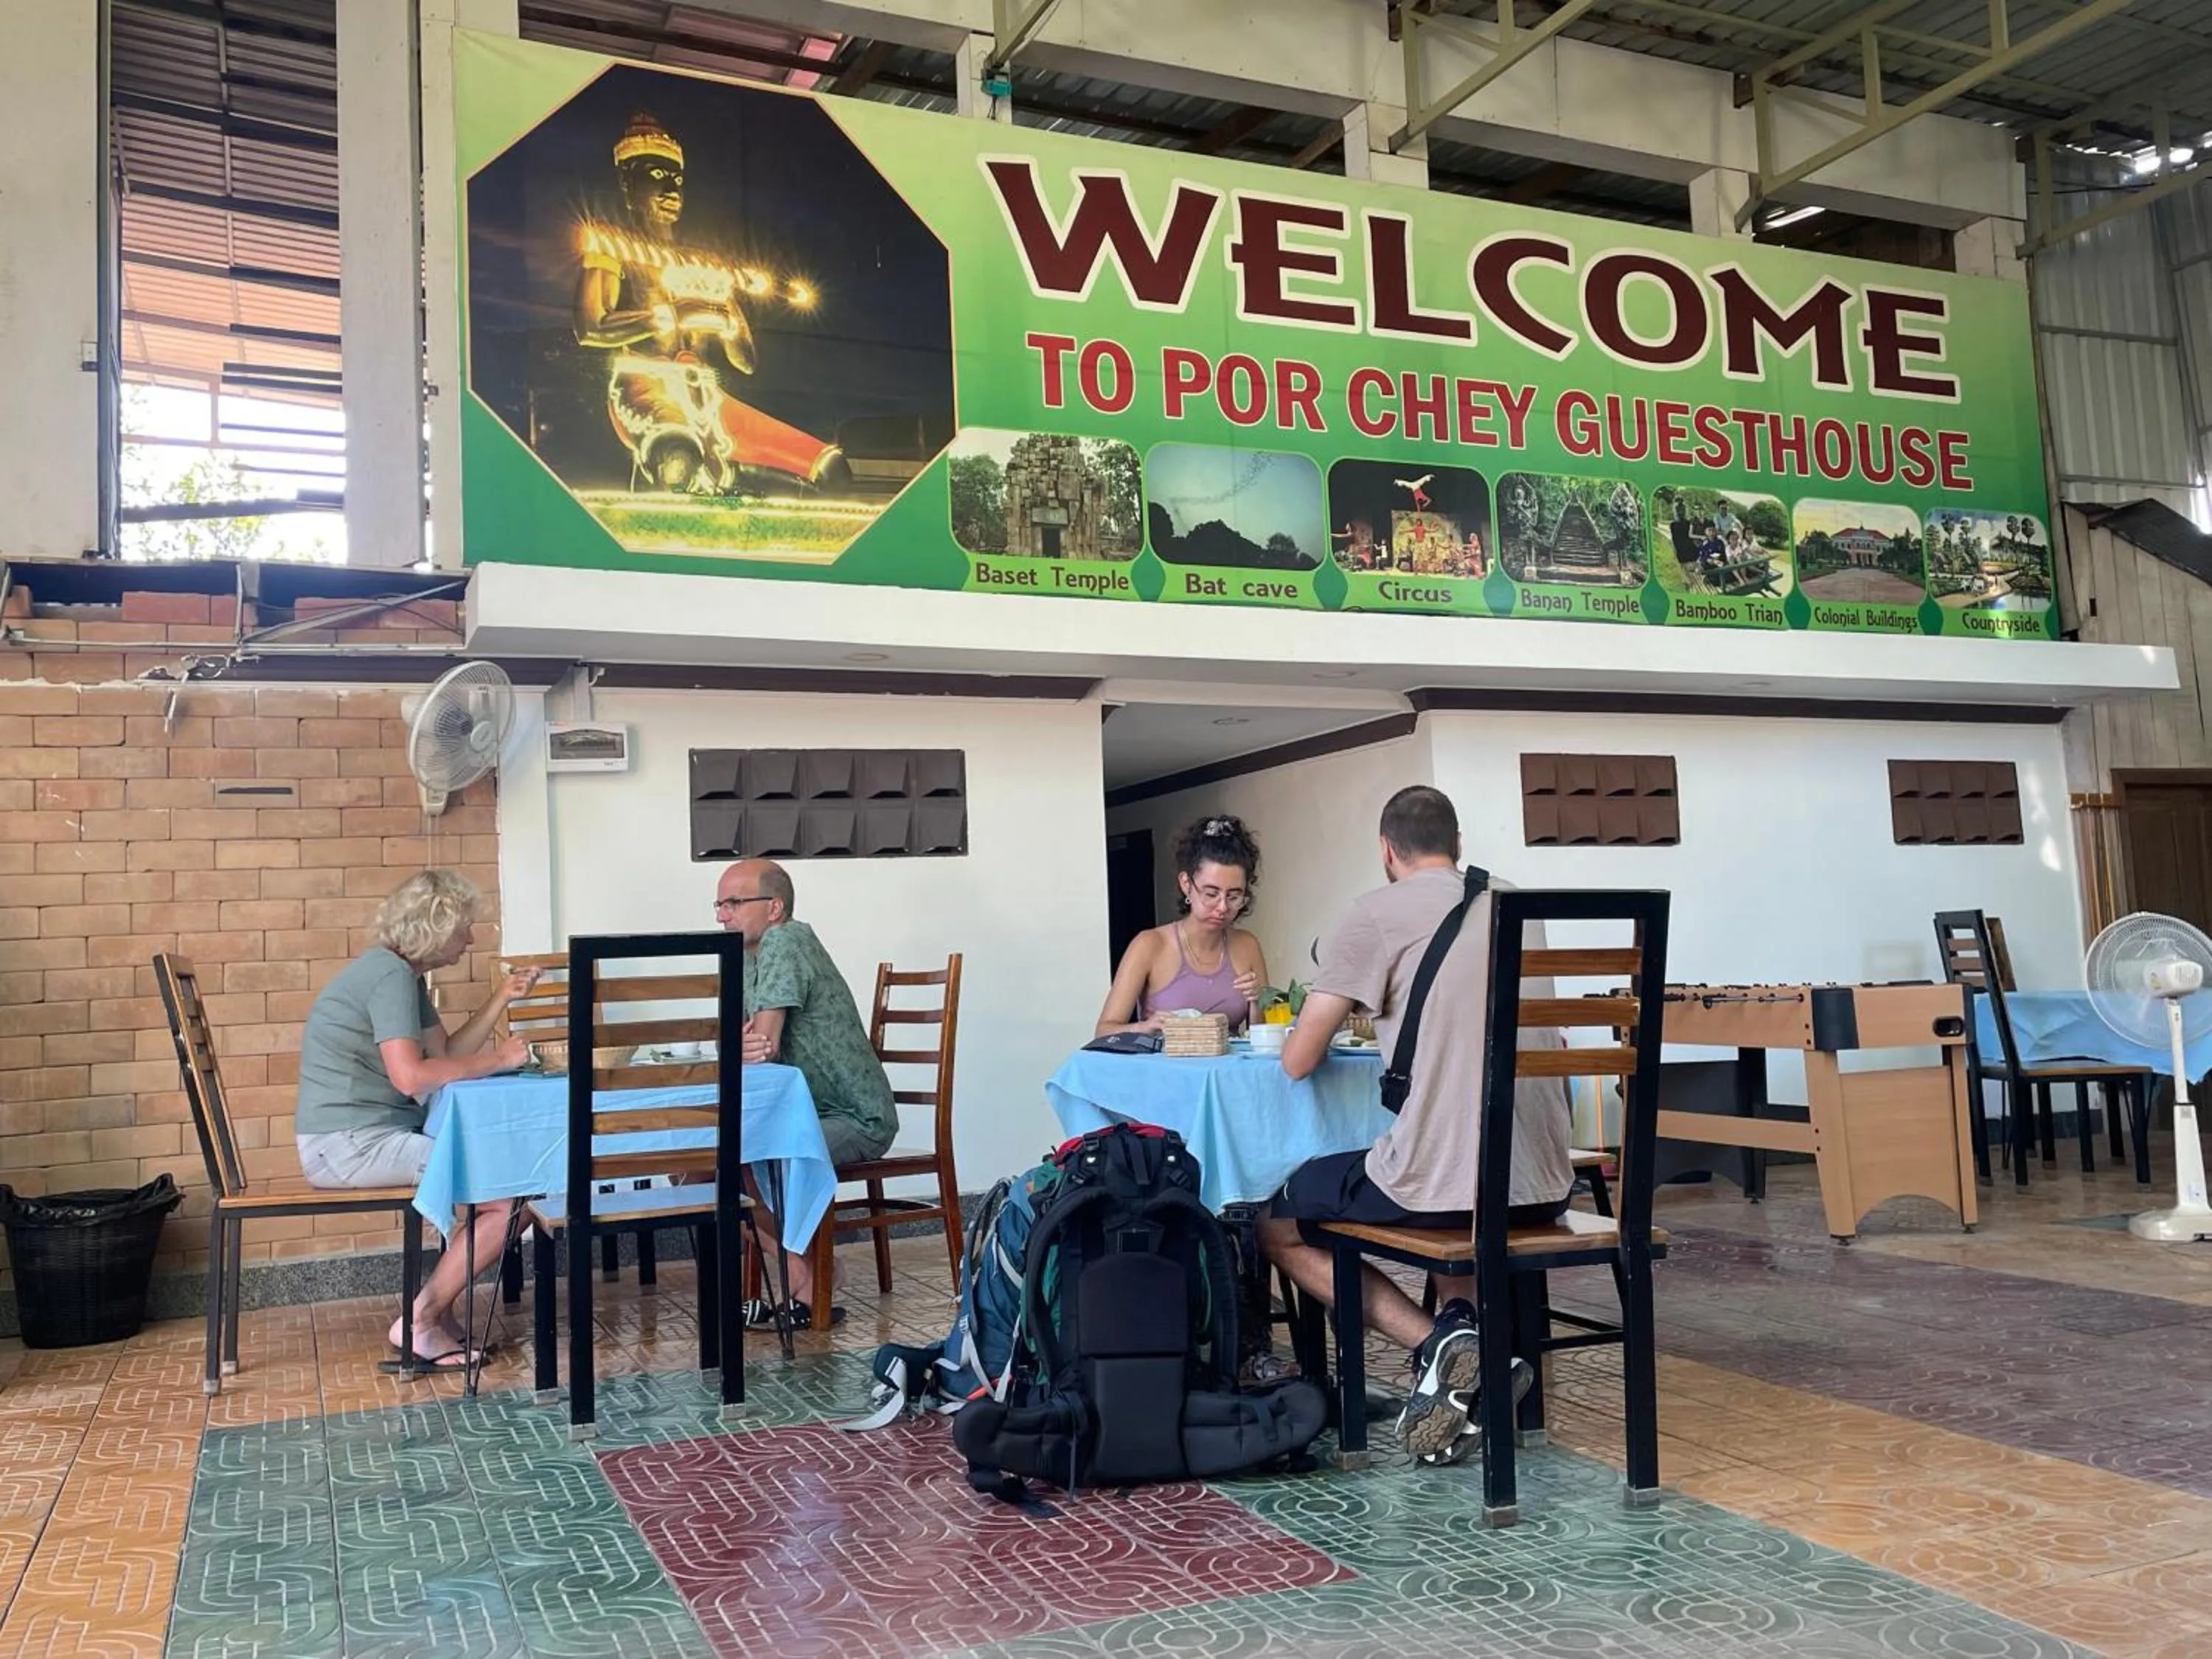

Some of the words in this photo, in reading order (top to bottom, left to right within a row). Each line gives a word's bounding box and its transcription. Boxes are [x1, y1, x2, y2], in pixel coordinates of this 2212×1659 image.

[979, 154, 1961, 403] WELCOME
[1026, 331, 1135, 415] TO
[1161, 346, 1327, 433] POR
[1346, 367, 1537, 449] CHEY
[1556, 389, 1975, 493] GUESTHOUSE
[975, 562, 1038, 586] Baset
[1050, 566, 1130, 595] Temple
[1185, 572, 1228, 596] Bat
[1242, 582, 1298, 599] cave
[1378, 580, 1453, 603] Circus
[1521, 588, 1573, 613] Banan
[1580, 591, 1640, 618] Temple
[1675, 599, 1737, 621] Bamboo
[1744, 603, 1784, 626] Trian
[1814, 607, 1860, 627] Colonial
[1962, 612, 2041, 636] Countryside
